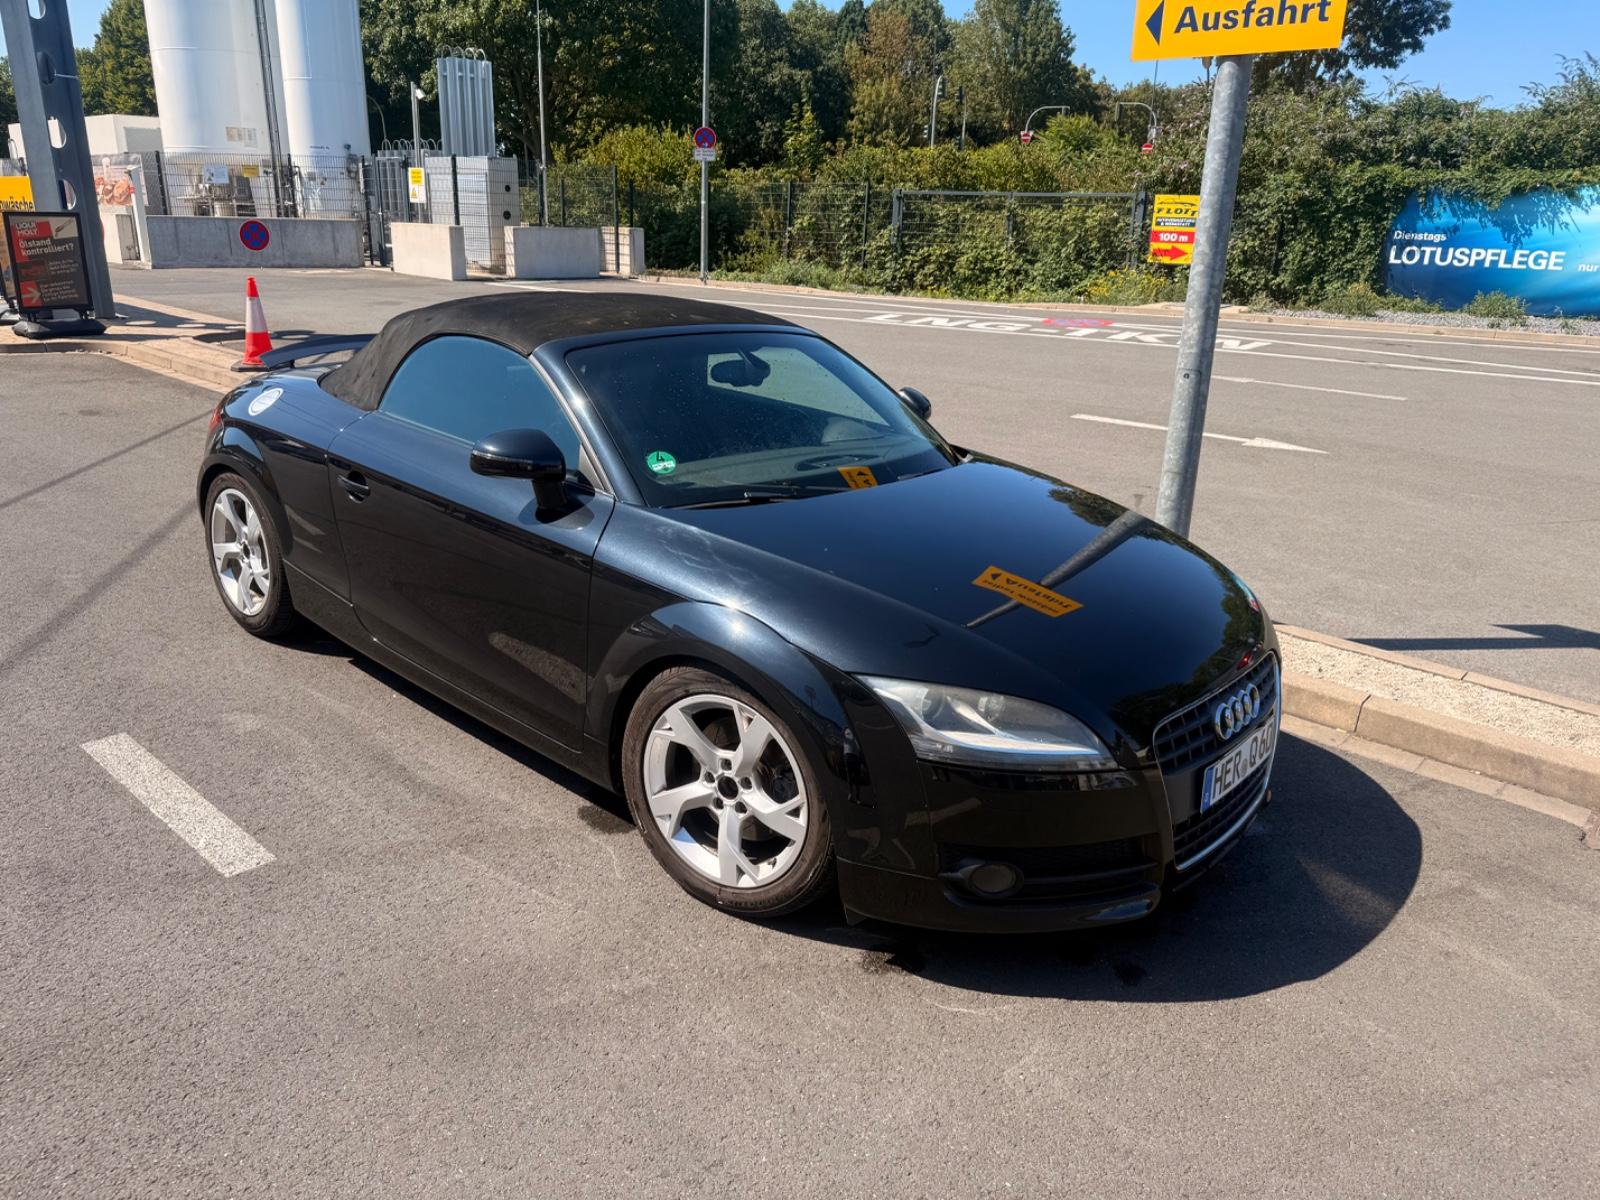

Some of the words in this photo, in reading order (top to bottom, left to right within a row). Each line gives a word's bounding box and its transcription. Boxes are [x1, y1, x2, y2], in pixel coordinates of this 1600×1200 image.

[1174, 0, 1331, 33] Ausfahrt
[19, 237, 51, 248] Ölstand
[1159, 232, 1178, 242] 100
[1178, 235, 1188, 243] m
[1394, 230, 1447, 243] Dienstags
[21, 242, 74, 256] kontrolliert?
[1389, 245, 1566, 271] LOTUSPFLEGE
[1578, 263, 1599, 272] nur
[1213, 750, 1242, 799] HER
